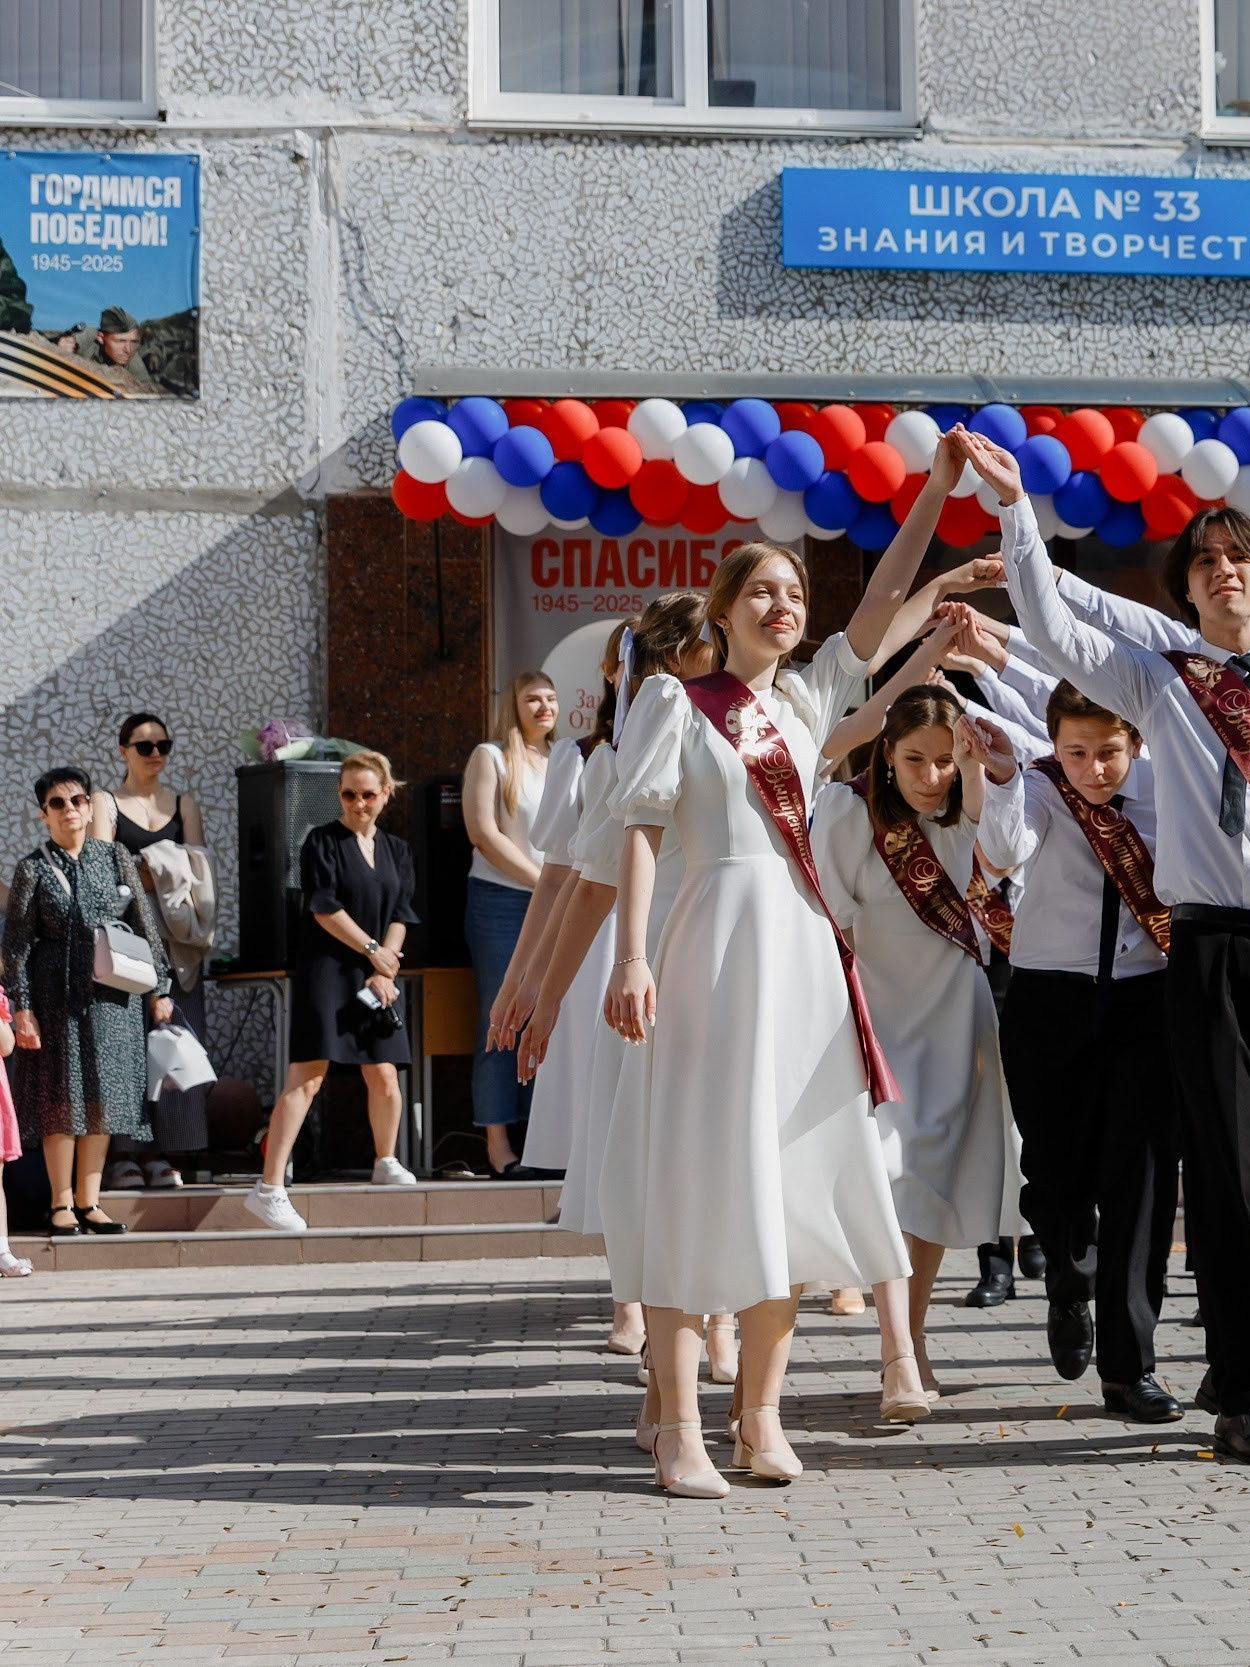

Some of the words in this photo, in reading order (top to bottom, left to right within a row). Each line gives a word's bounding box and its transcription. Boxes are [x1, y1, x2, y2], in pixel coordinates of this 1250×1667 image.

[30, 173, 182, 211] ГОРДИМСЯ
[908, 183, 1081, 220] ШКОЛА
[1094, 188, 1141, 222] №
[1153, 191, 1201, 223] 33
[30, 211, 169, 250] ПОБЕДОЙ!
[817, 226, 986, 255] ЗНАНИЯ
[1001, 231, 1026, 256] И
[530, 538, 765, 588] СПАСИБ
